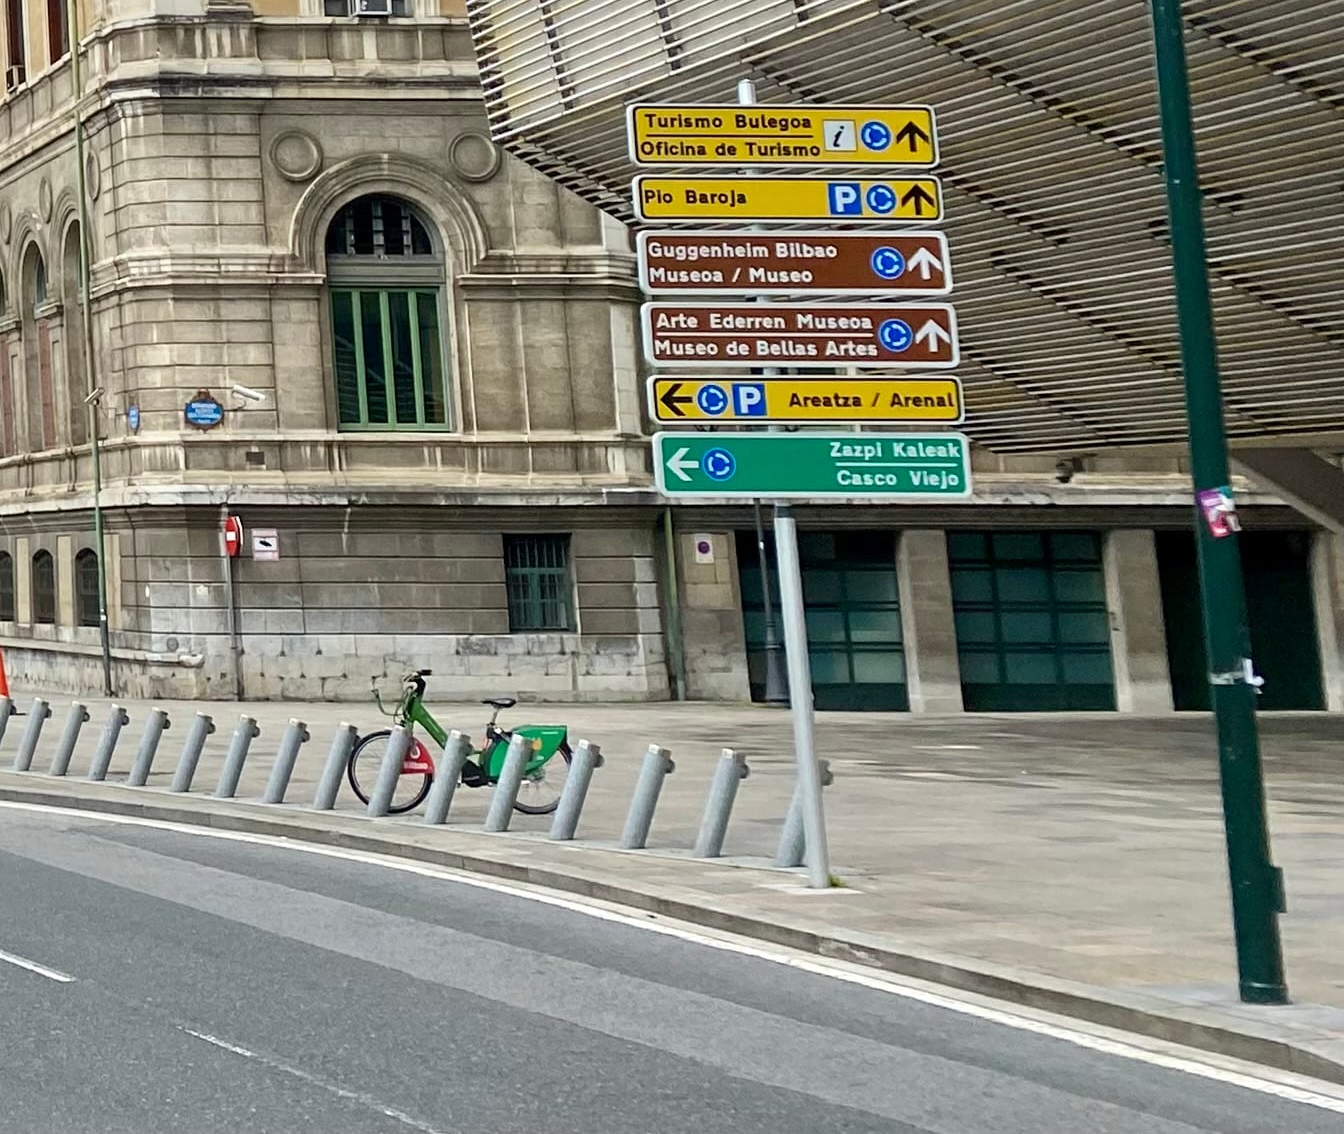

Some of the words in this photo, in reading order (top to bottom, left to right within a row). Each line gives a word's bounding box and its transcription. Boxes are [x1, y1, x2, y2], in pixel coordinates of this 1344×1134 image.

[644, 113, 723, 129] Turismo
[735, 113, 812, 132] Bulegoa
[640, 140, 707, 157] Oficina
[714, 141, 737, 157] de
[747, 142, 821, 158] Turismo
[644, 189, 673, 205] Pio
[685, 189, 747, 208] Baroja
[835, 186, 857, 212] P
[648, 241, 769, 261] Guggenheim
[775, 242, 838, 259] Bilbao
[649, 267, 724, 283] Museoa
[749, 267, 813, 283] Museo
[656, 313, 698, 330] Arte
[709, 313, 786, 330] Ederren
[796, 314, 873, 330] Museoa
[654, 340, 718, 356] Museo
[725, 340, 750, 356] de
[756, 340, 818, 356] Bellas
[825, 341, 878, 357] Artes
[739, 386, 761, 413] P
[788, 392, 862, 409] Areatza
[890, 392, 954, 409] Arenal
[830, 442, 882, 461] Zazpi
[894, 441, 960, 458] Kaleak
[837, 470, 897, 486] Casco
[911, 470, 960, 489] Viejo
